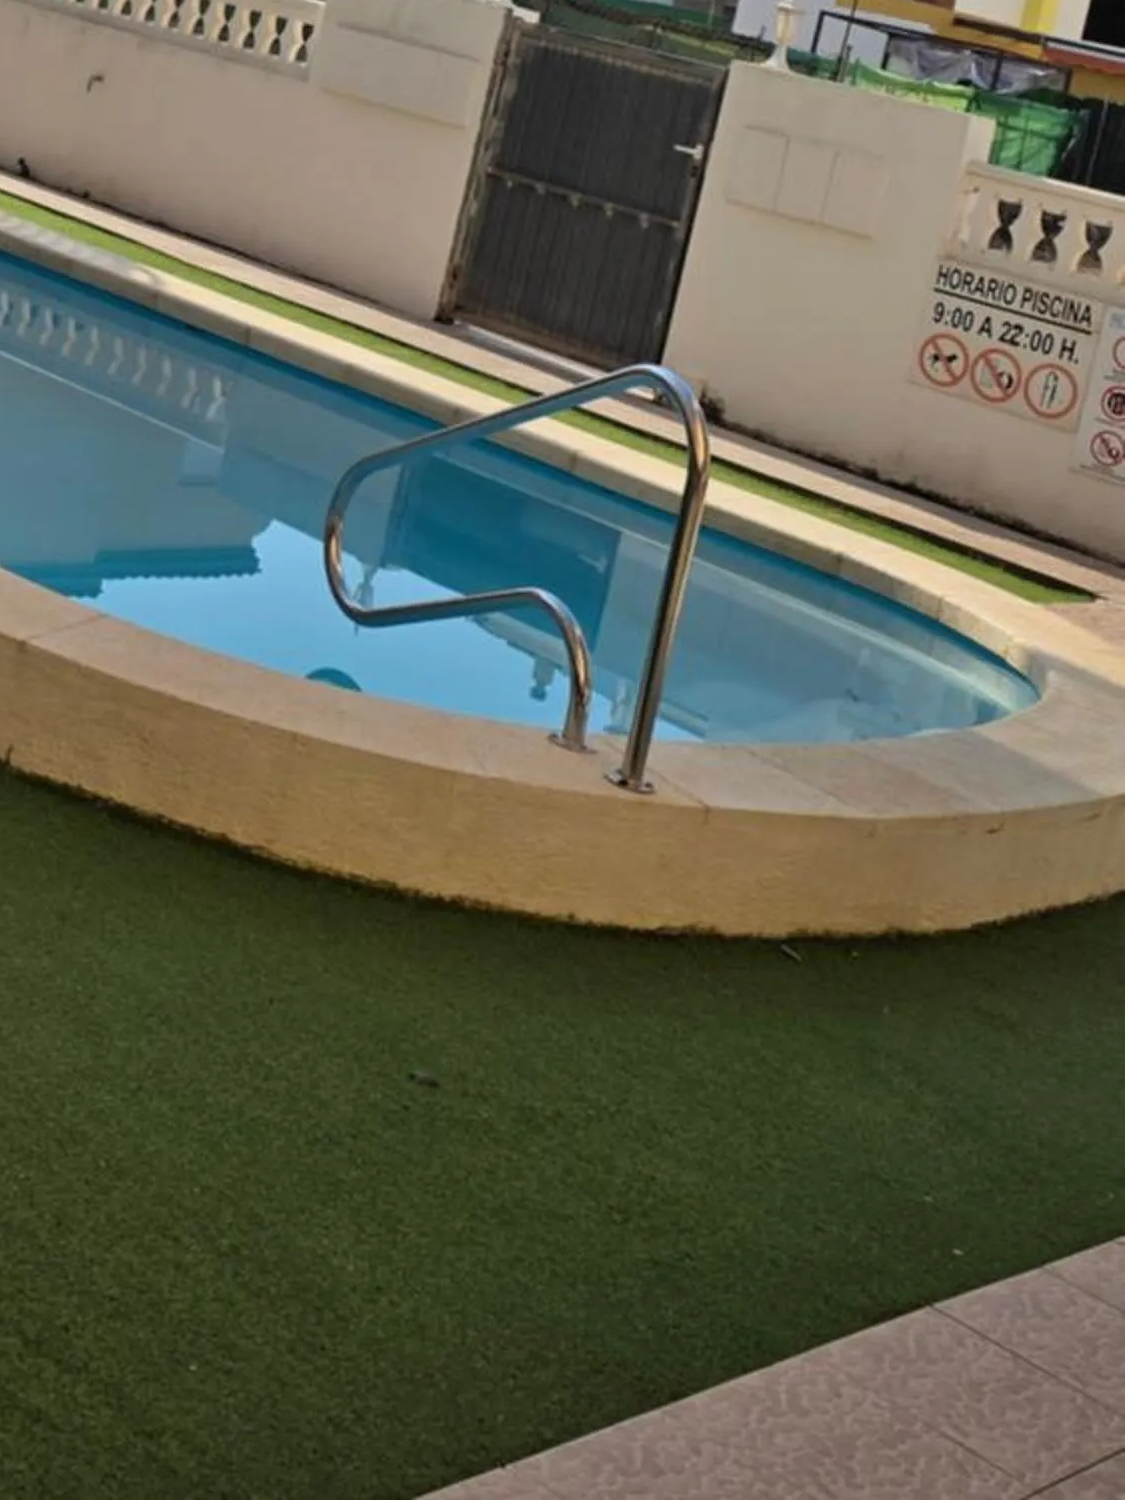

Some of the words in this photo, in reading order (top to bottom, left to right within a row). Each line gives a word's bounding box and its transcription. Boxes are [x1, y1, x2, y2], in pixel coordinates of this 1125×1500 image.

[936, 265, 1017, 305] HORARIO
[1020, 287, 1093, 327] PISCINA
[932, 302, 975, 332] 9:00
[977, 316, 993, 339] A
[998, 321, 1055, 355] 22:00
[1058, 337, 1080, 365] H.
